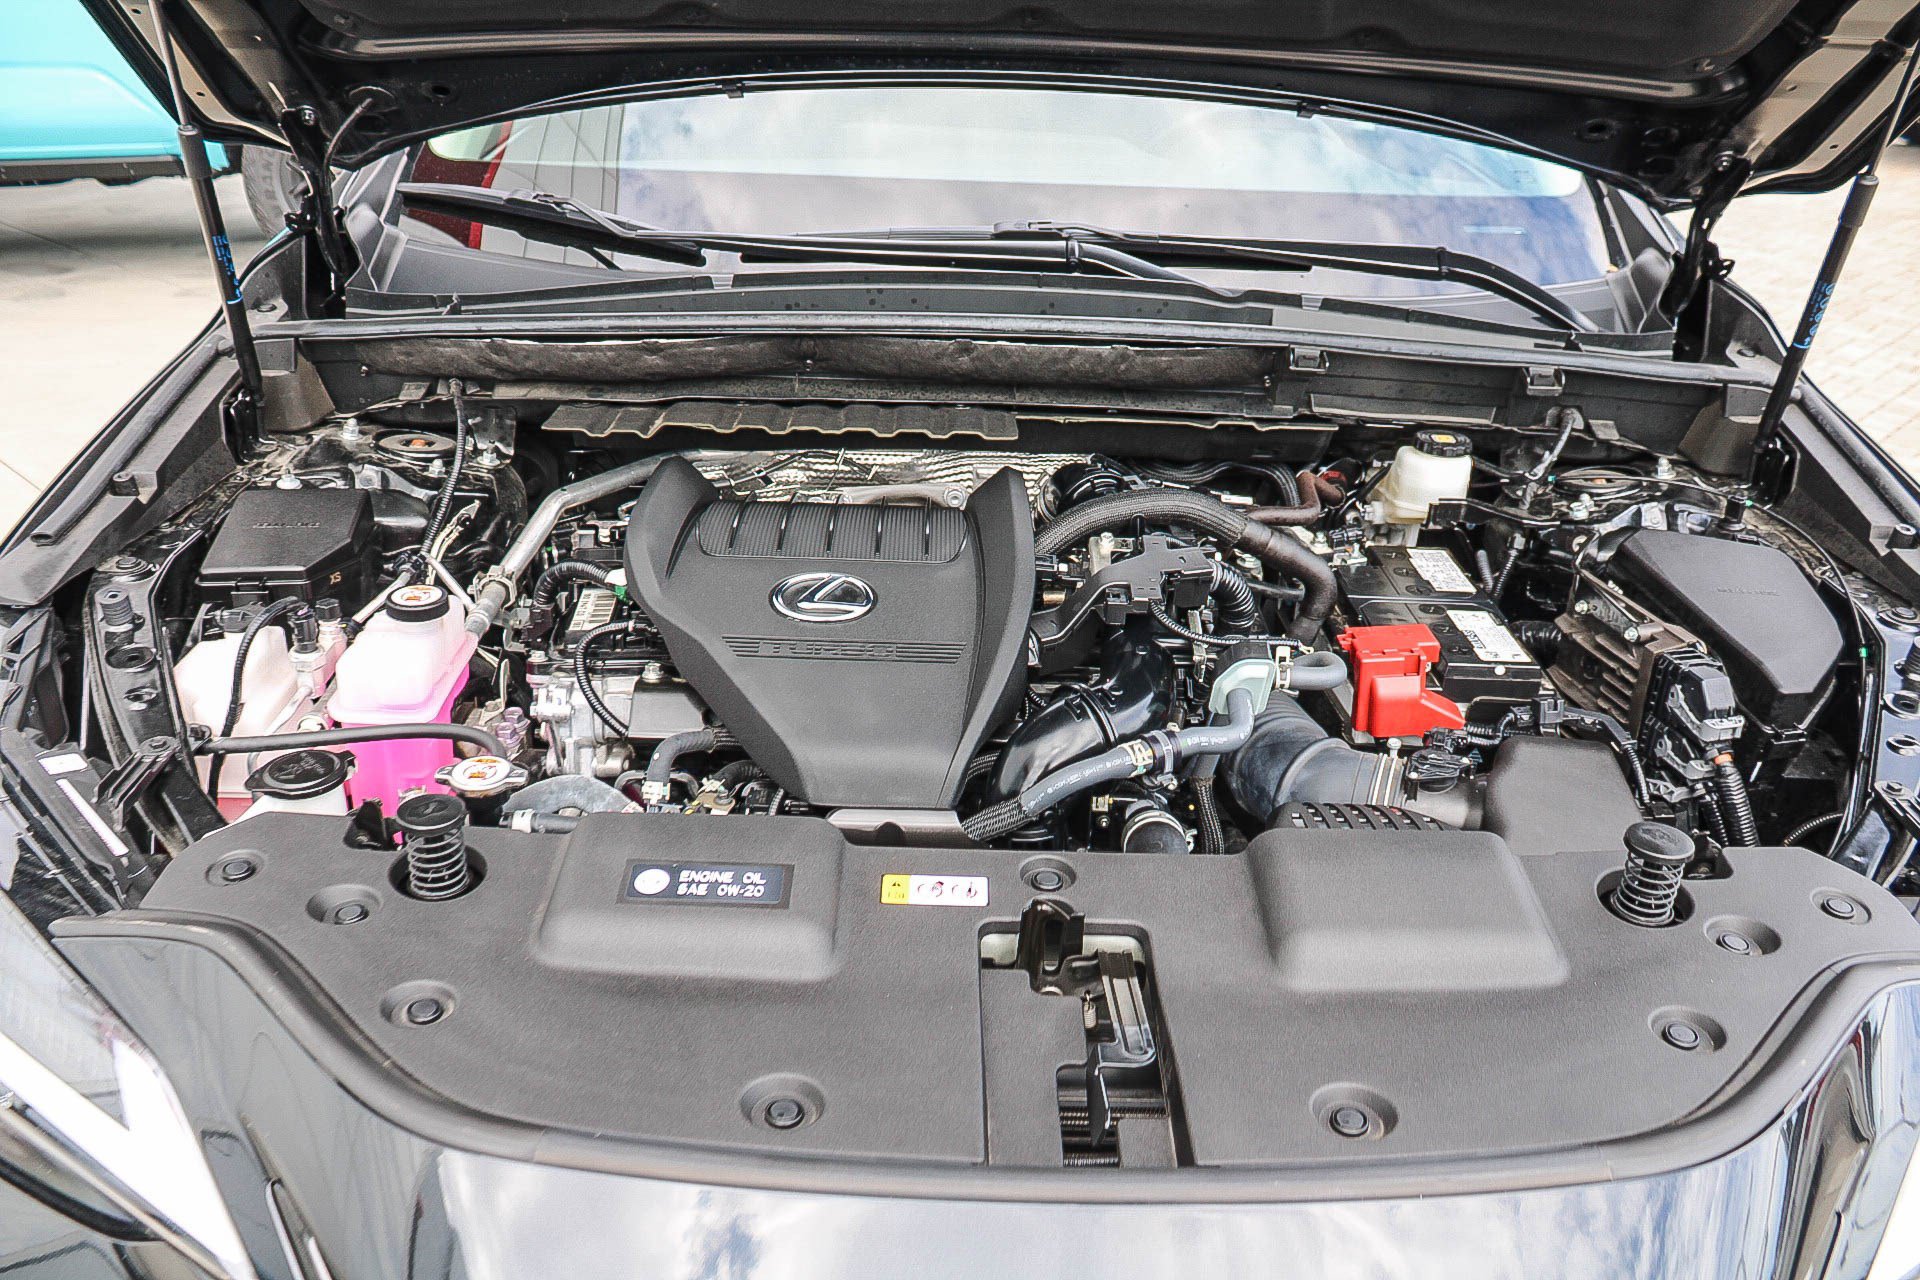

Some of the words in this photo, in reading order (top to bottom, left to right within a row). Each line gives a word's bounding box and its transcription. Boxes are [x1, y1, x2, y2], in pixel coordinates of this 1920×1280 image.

[762, 641, 894, 658] TURBO
[678, 869, 734, 884] ENGINE
[742, 870, 767, 885] OIL
[676, 882, 710, 896] SAE
